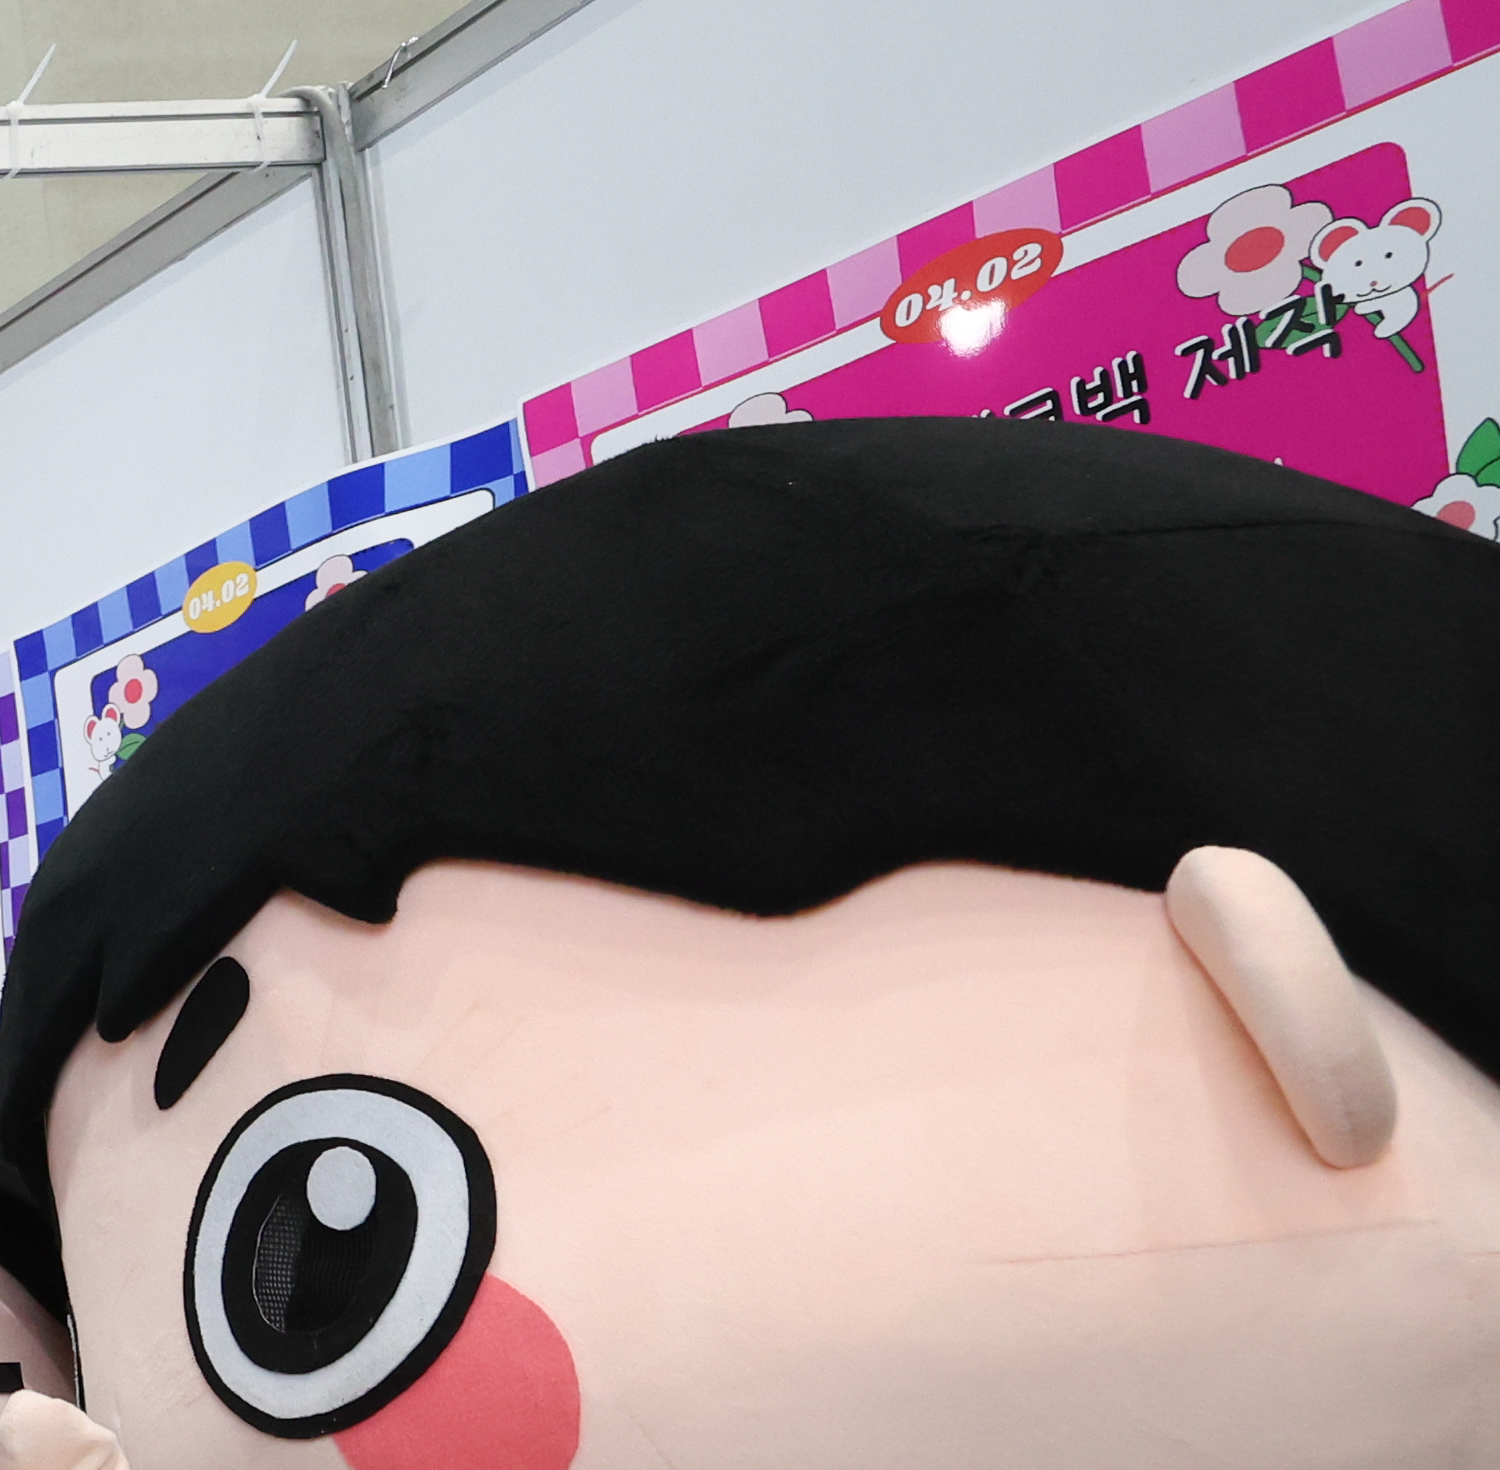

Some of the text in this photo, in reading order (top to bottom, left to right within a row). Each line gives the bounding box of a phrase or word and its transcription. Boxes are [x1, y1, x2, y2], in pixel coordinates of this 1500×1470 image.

[893, 241, 1044, 329] 04.02
[1174, 282, 1346, 400] 제작
[187, 572, 251, 621] 04.02
